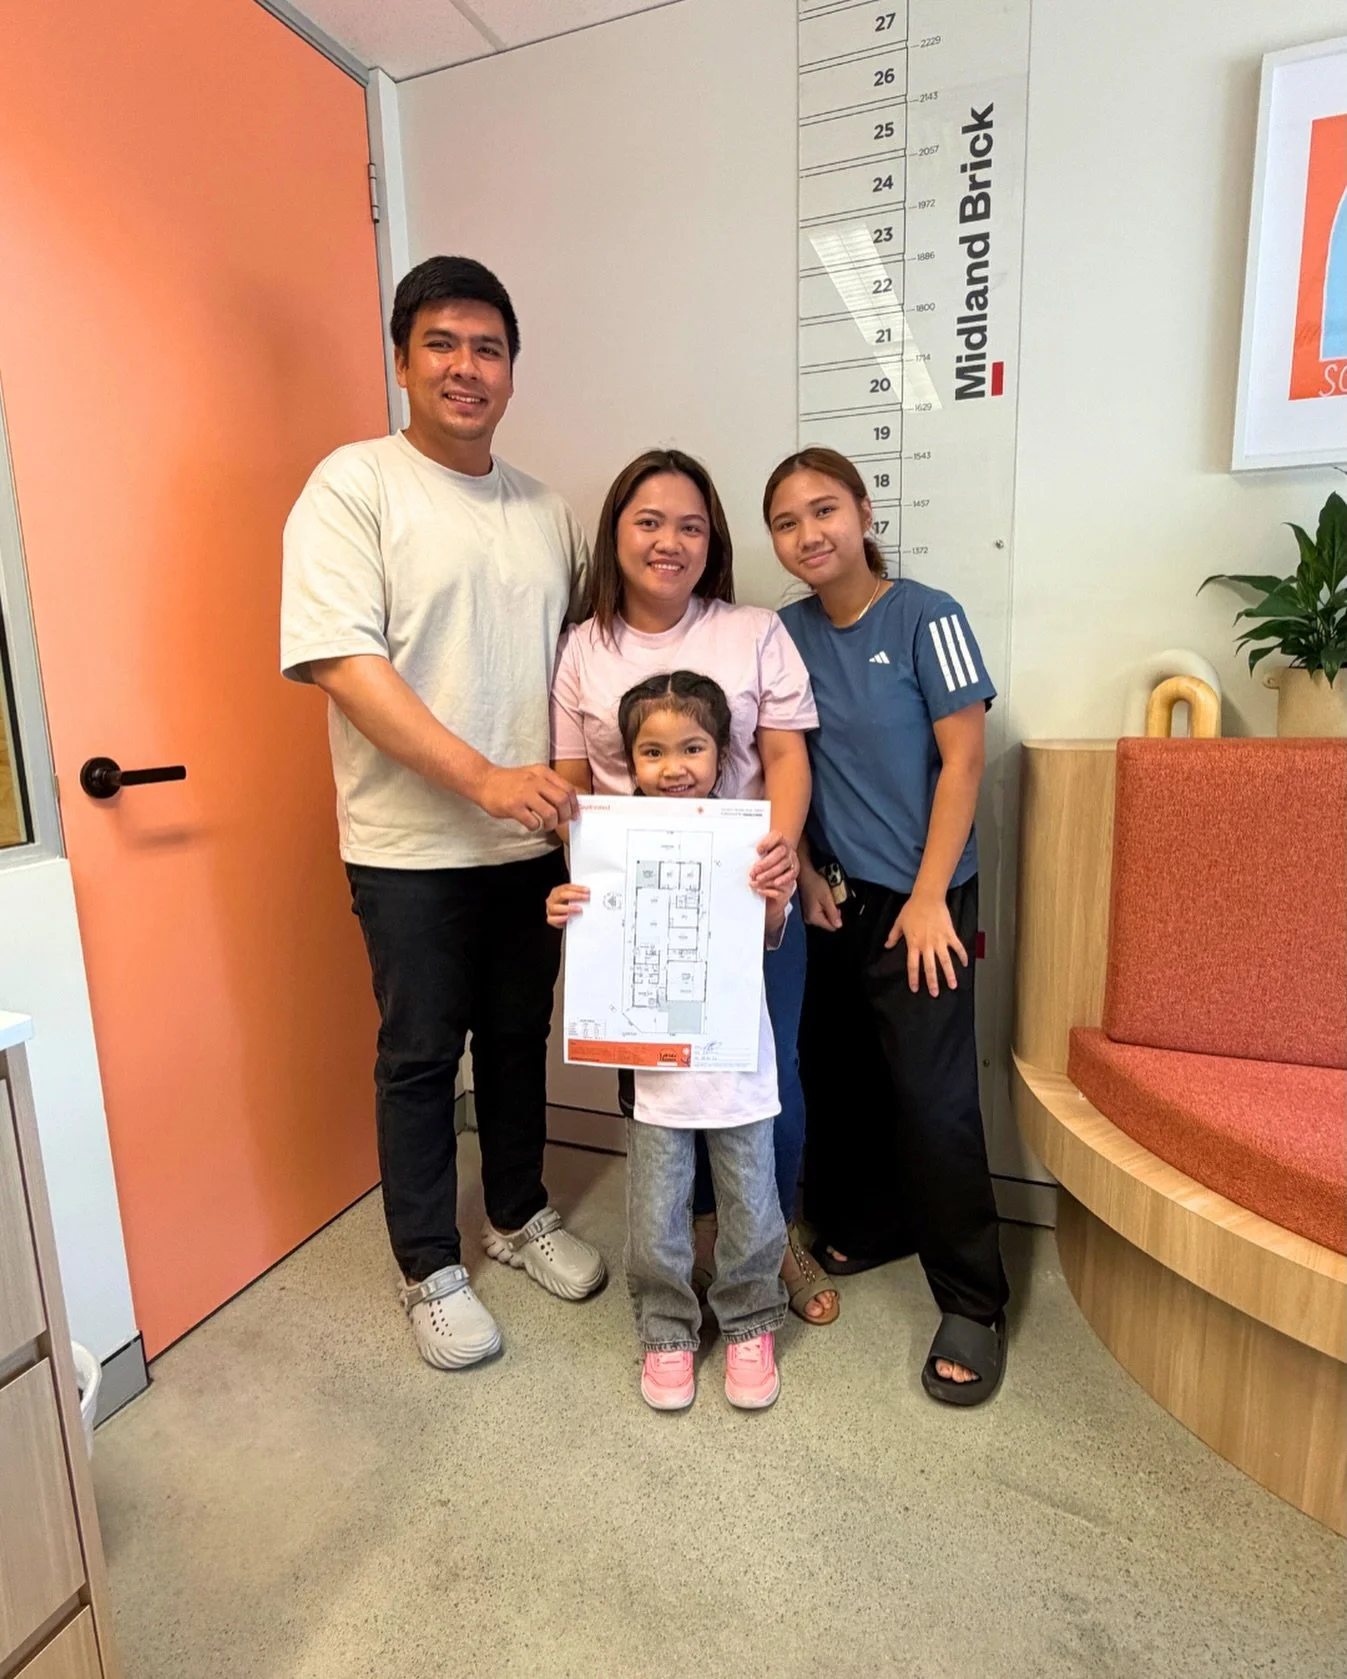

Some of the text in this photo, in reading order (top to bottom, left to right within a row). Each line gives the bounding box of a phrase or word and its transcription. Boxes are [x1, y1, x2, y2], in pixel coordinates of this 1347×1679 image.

[875, 13, 896, 32] 27
[921, 36, 941, 48] 2229
[874, 68, 895, 86] 26
[920, 91, 938, 103] 2143
[874, 122, 894, 140] 25
[919, 144, 939, 156] 2057
[873, 175, 893, 192] 24
[917, 199, 935, 209] 1972
[873, 227, 893, 243] 23
[955, 103, 994, 401] Midland Brick
[872, 278, 892, 294] 22
[916, 303, 935, 312] 1800
[875, 328, 891, 343] 21
[870, 378, 891, 393] 20
[873, 426, 891, 440] 19
[914, 452, 931, 460] 1543
[873, 474, 890, 488] 18
[873, 521, 889, 534] 17
